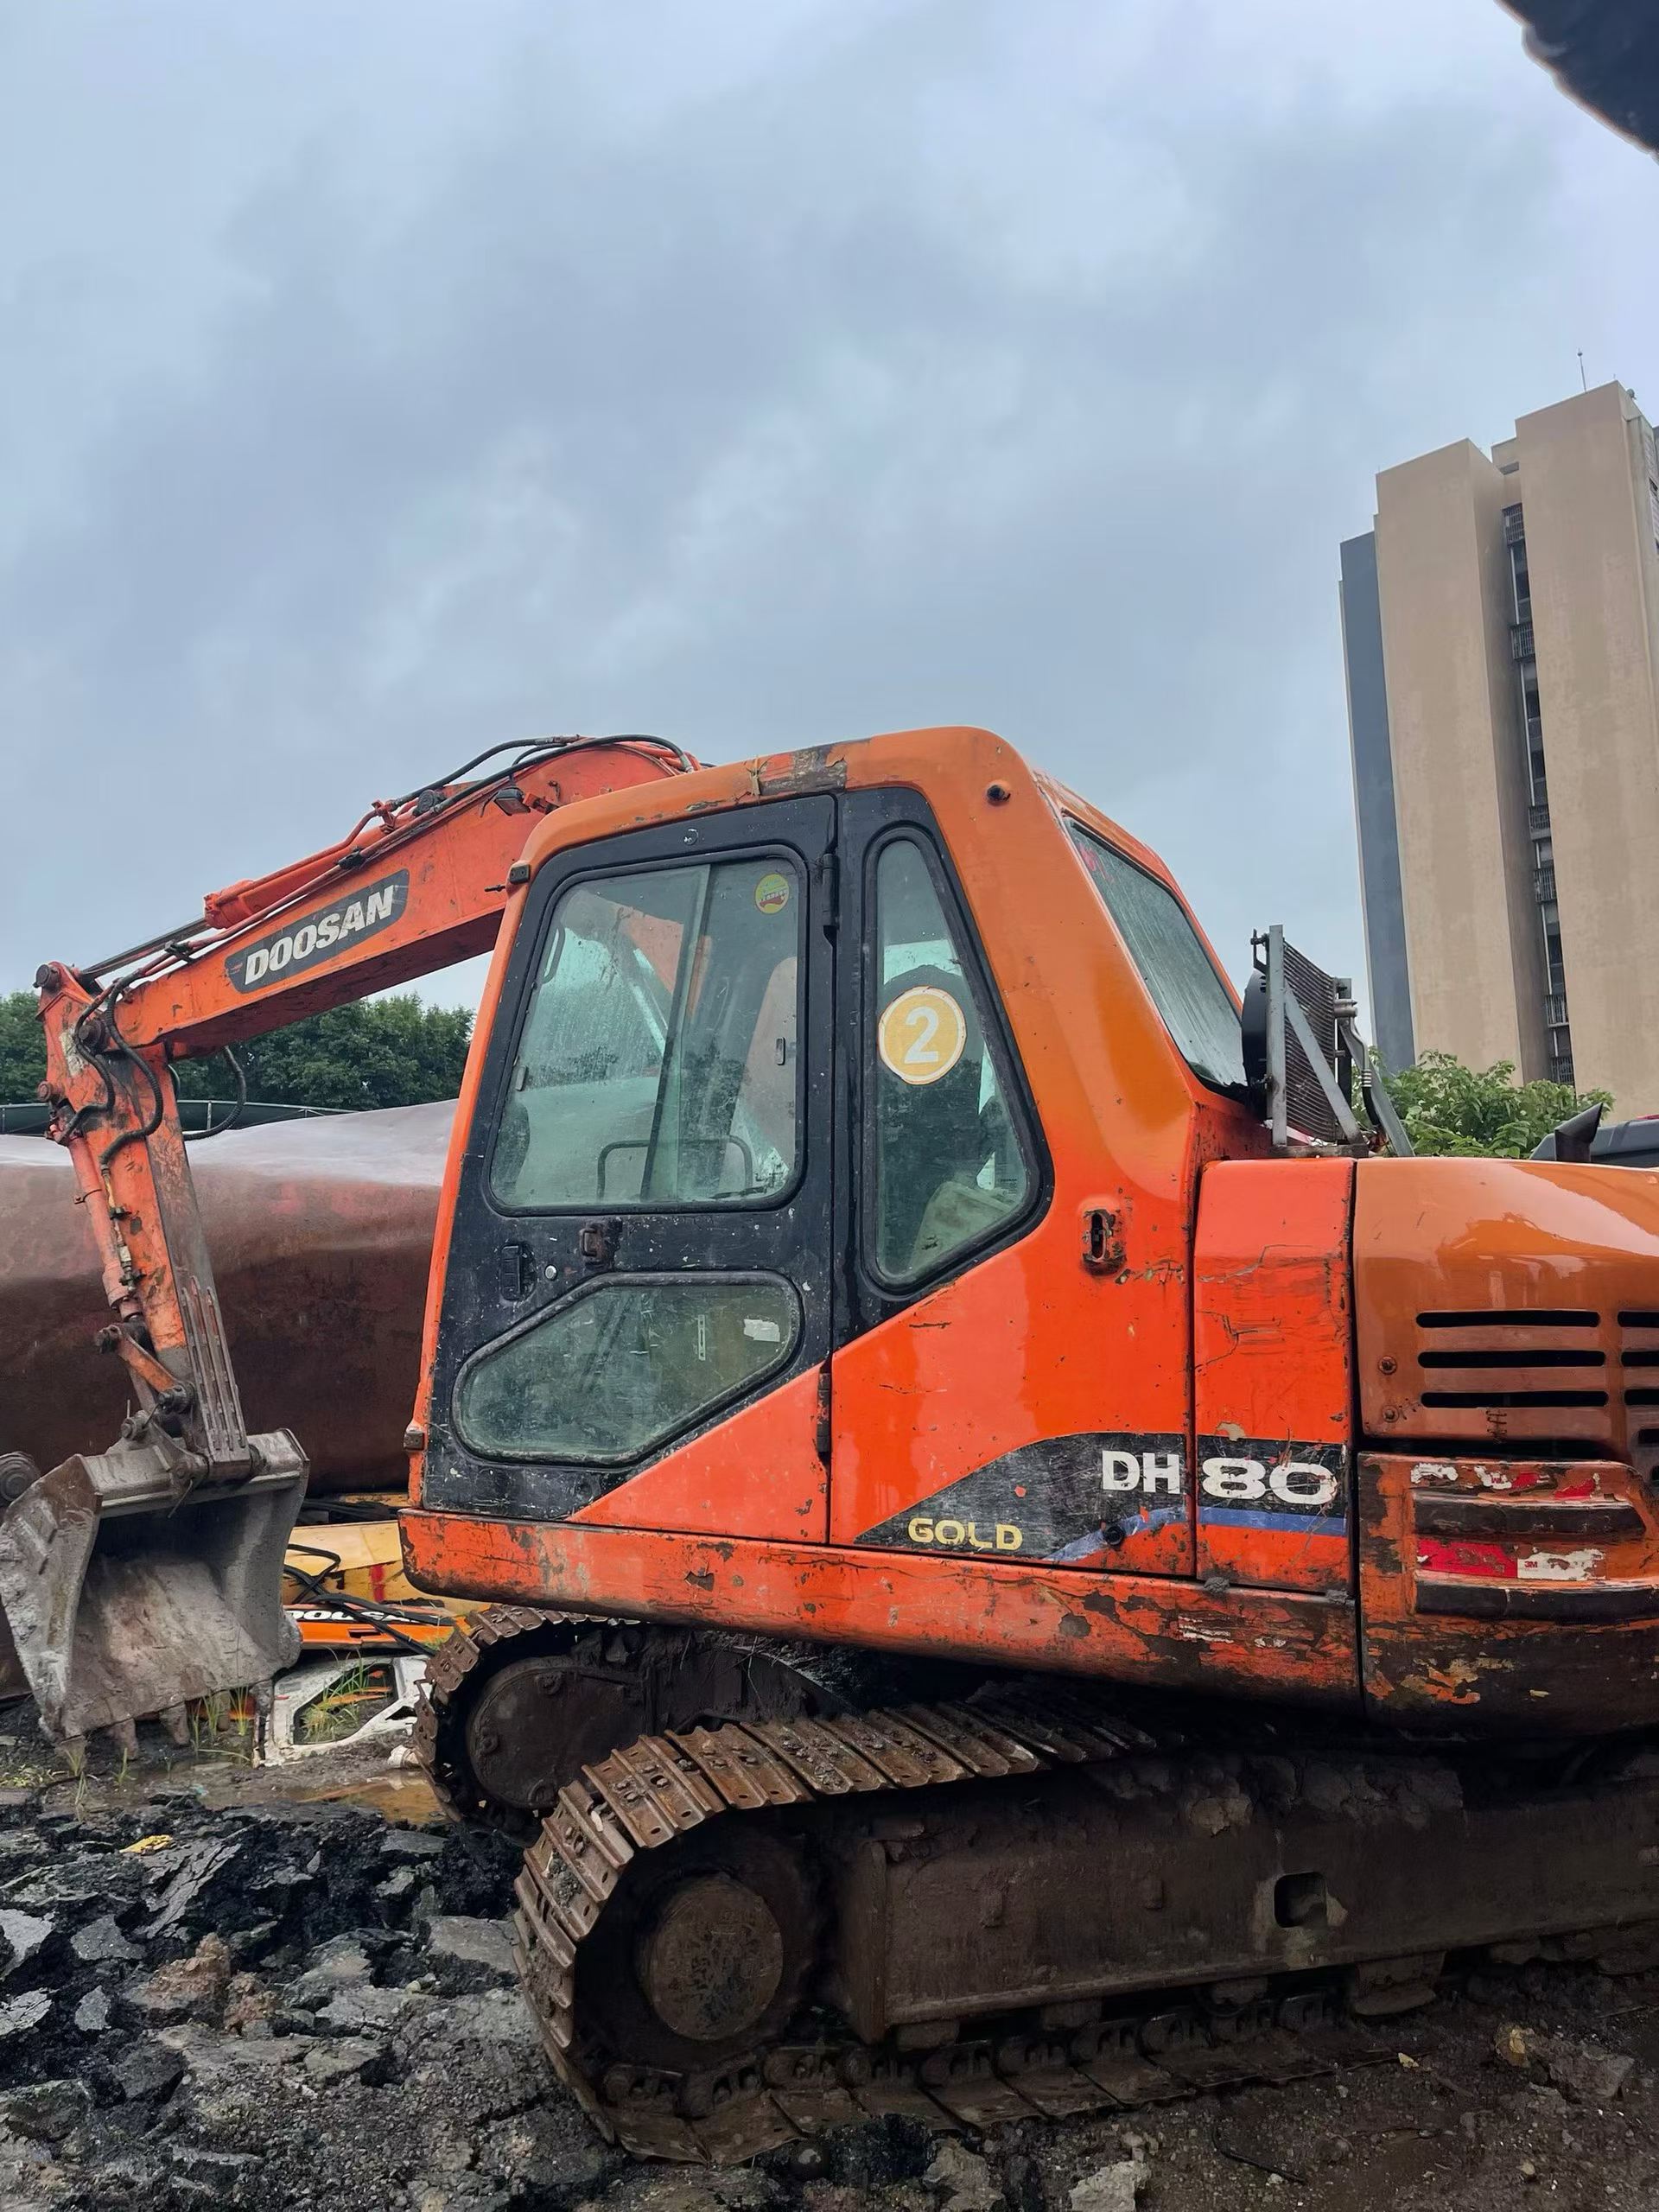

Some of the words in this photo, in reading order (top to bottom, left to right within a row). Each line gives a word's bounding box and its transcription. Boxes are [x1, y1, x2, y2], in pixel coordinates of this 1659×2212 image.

[245, 884, 394, 985] DOOSAN
[904, 1006, 939, 1064] 2
[1102, 1450, 1180, 1494] DH
[1202, 1457, 1338, 1505] 80
[908, 1517, 1023, 1551] GOLD
